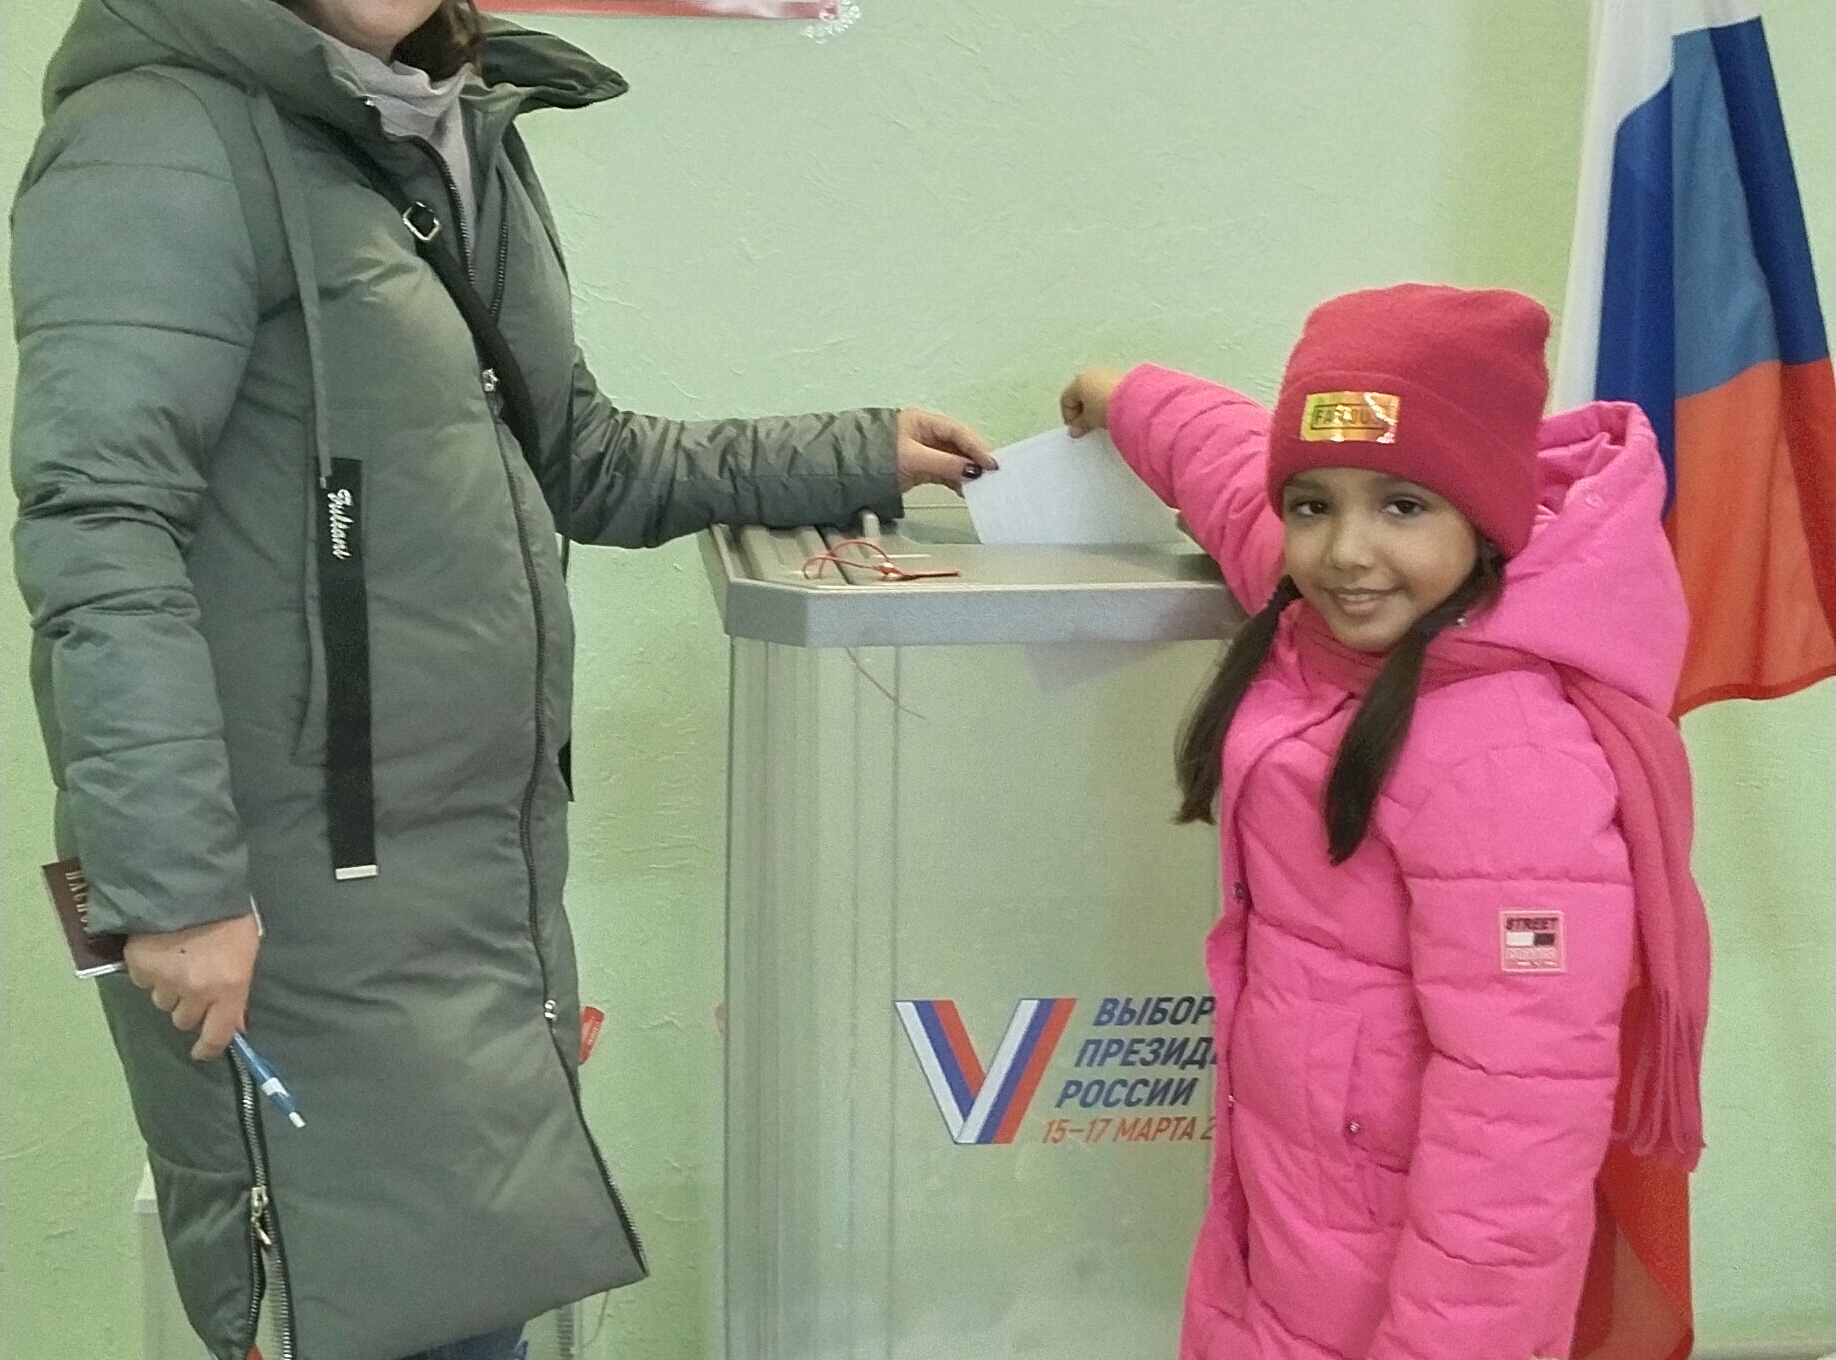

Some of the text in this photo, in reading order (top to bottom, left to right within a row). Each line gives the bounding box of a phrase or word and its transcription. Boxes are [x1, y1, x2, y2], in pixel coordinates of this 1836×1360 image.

[1506, 917, 1559, 930] STREET
[1093, 996, 1216, 1026] ВЫБОР
[1074, 1037, 1218, 1070] ПРЕЗИД
[1055, 1077, 1199, 1108] РОССИИ
[1113, 1116, 1198, 1142] МАРТА
